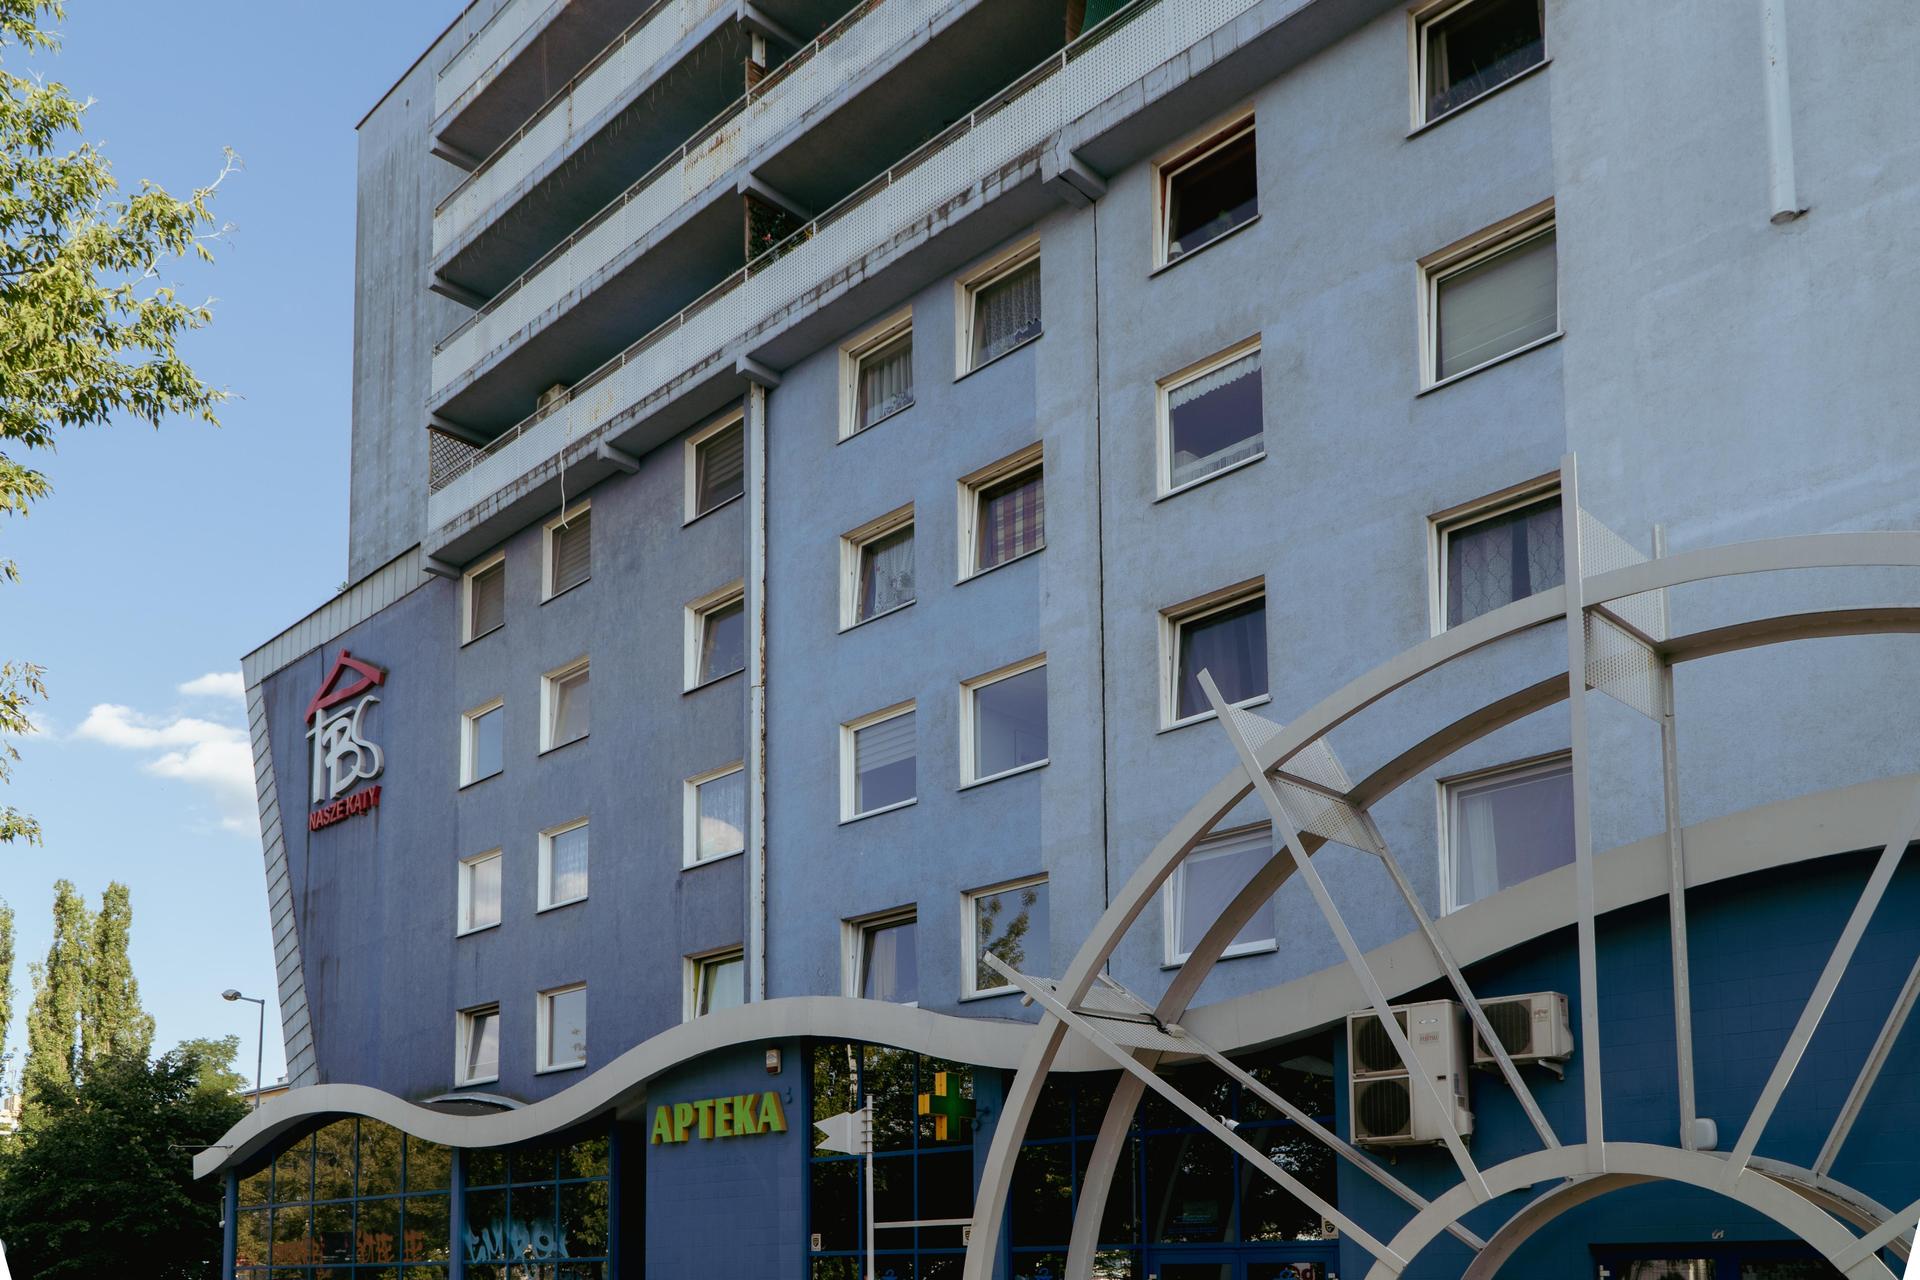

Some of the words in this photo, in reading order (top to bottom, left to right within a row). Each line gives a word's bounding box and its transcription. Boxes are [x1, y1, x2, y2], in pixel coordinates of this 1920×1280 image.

[305, 695, 384, 803] TBS
[309, 800, 348, 831] NASZE
[650, 1091, 787, 1144] APTEKA
